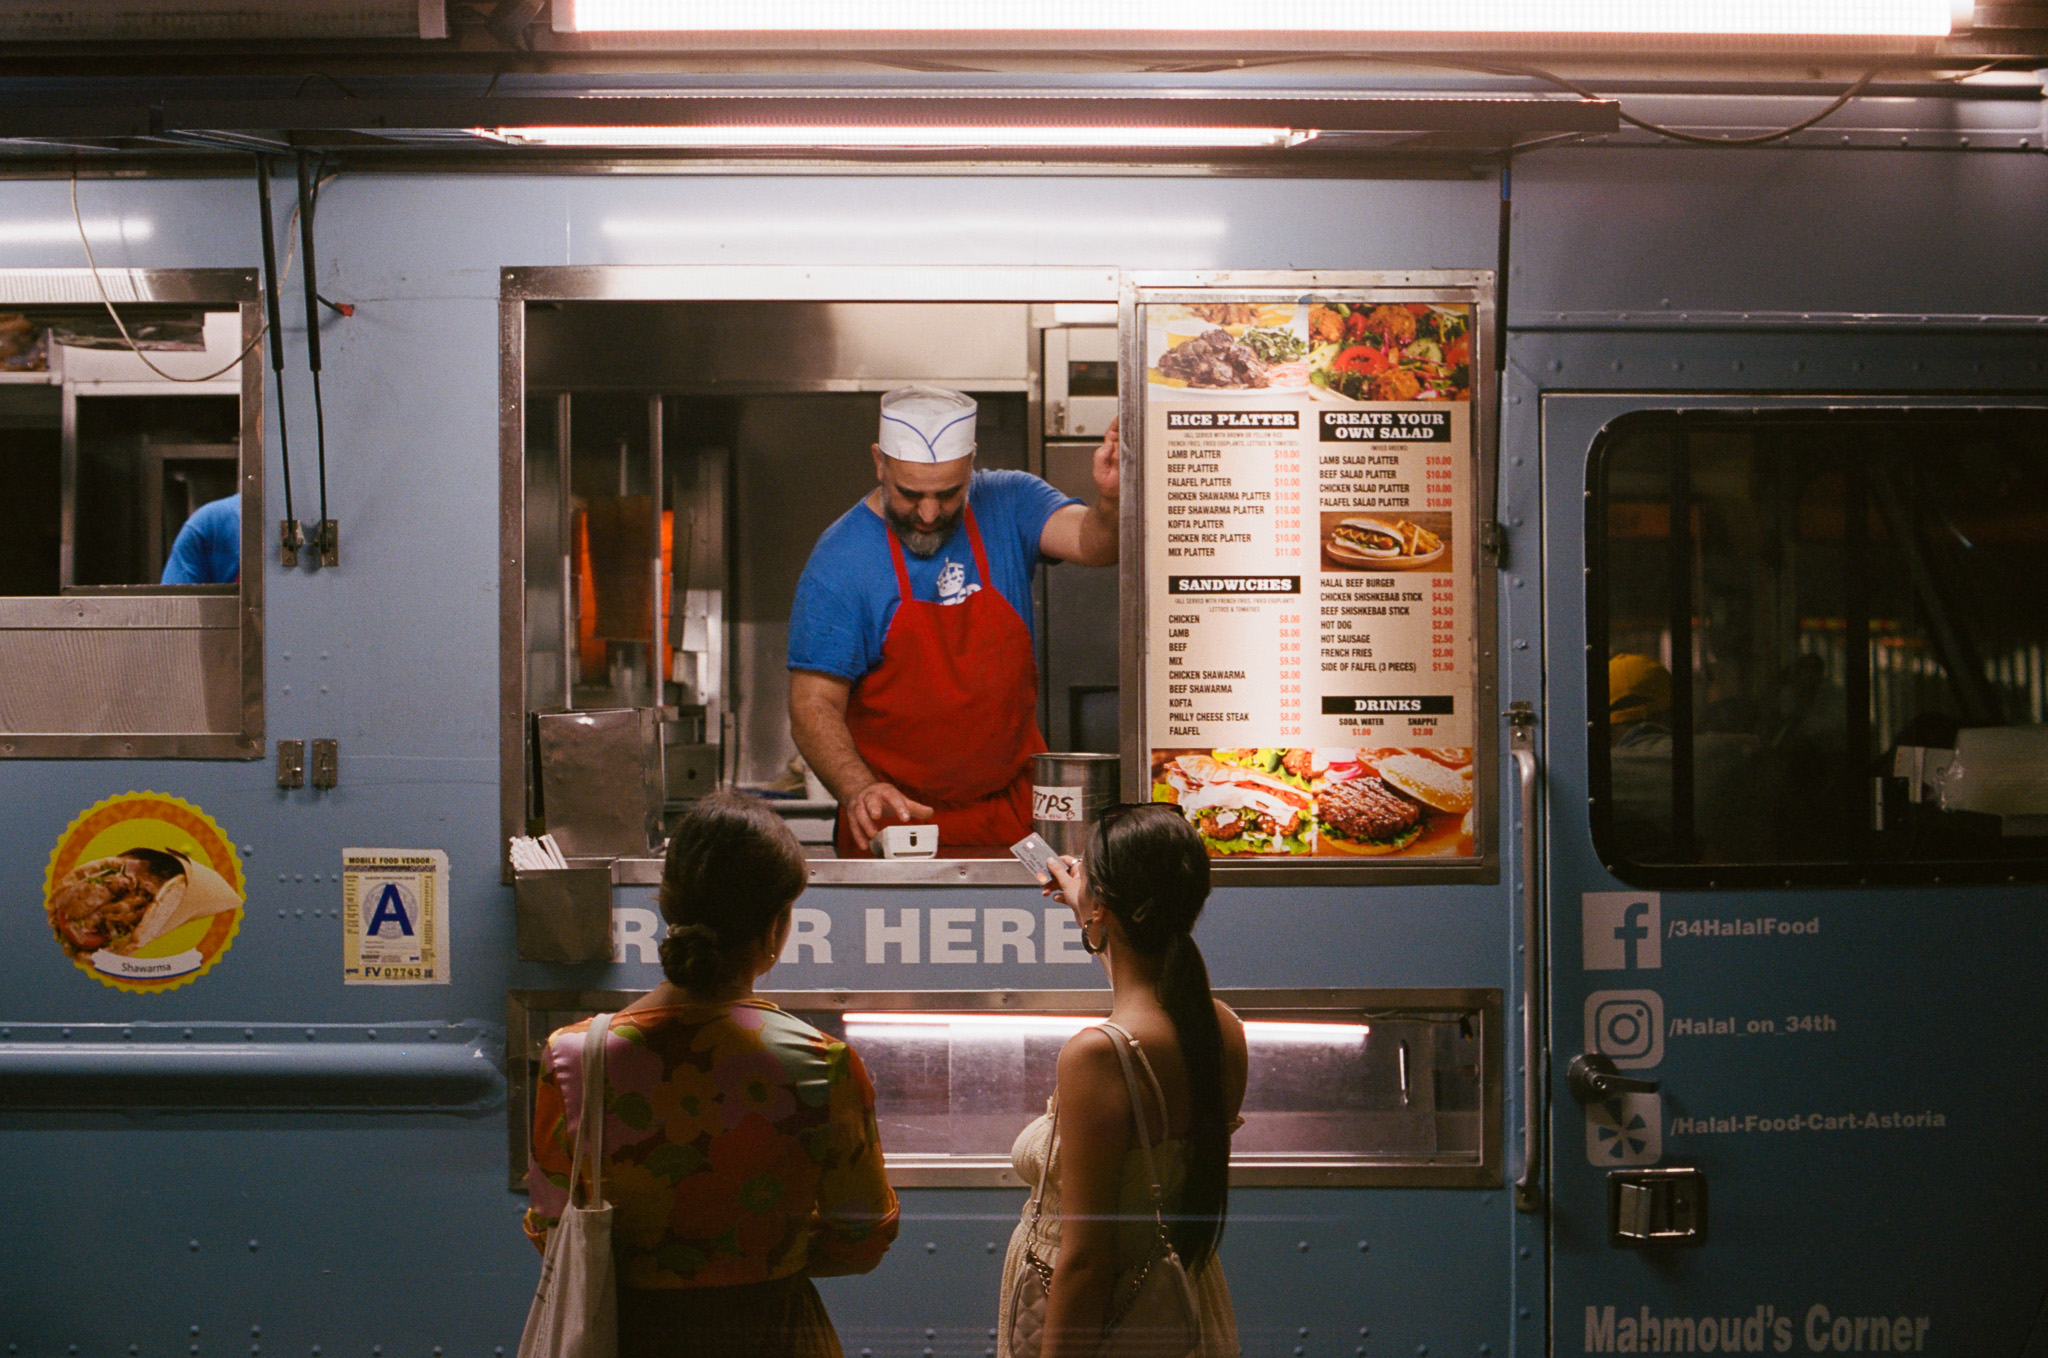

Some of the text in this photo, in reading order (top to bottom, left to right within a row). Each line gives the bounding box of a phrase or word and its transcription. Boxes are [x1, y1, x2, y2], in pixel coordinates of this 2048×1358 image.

[1170, 414, 1296, 425] RICE PLATTER
[1325, 414, 1444, 424] CREATE YOUR
[1336, 428, 1434, 438] OWN SALAD
[1168, 450, 1299, 458] LAMB PLATTER $10.00
[1320, 456, 1452, 465] LAMB SALAD PLATTER $10.00
[1168, 464, 1299, 472] BEEF PLATTER $10.00
[1320, 470, 1452, 479] BEEF SALAD PLATTER $10.00
[1168, 478, 1300, 486] FALAFEL PLATTER $10.00
[1320, 484, 1452, 493] CHICKEN SALAD PLATTER $10.00
[1168, 492, 1300, 500] CHICKEN SHAWARMA PLATTER $10.00
[1320, 498, 1452, 507] FALAFEL SALAD PLATTER $10.00
[1168, 506, 1300, 514] BEEF SHAWARMA PLATTER $10.00
[1168, 520, 1300, 528] KOFTA PLATTER $10.00
[1168, 534, 1300, 542] CHICKEN RICE PLATTER $10.00
[1168, 548, 1300, 556] MIX PLATTER $11.00
[1179, 579, 1292, 590] SANDWICHES
[1321, 579, 1453, 587] HALAL BEEF BURGER $8.00
[1321, 593, 1453, 601] CHICKEN SHISHKEBAB STICK $4.50
[1321, 607, 1453, 615] BEEF SHISHKEBAB STICK $4.50
[1169, 615, 1299, 623] CHICKEN $8.00
[1321, 621, 1453, 629] HOT DOG $2.00
[1169, 629, 1300, 637] LAMB $8.00
[1321, 635, 1453, 643] HOT SAUSAGE $2.50
[1169, 643, 1300, 651] BEEF $8.00
[1321, 649, 1453, 657] FRENCH FRIES $2.00
[1169, 657, 1300, 665] MIX $9.50
[1321, 663, 1337, 671] SIDE
[1340, 663, 1348, 671] OF
[1351, 663, 1376, 671] FALFEL
[1379, 663, 1386, 672] (3
[1388, 663, 1416, 673] PIECES)
[1169, 671, 1300, 679] CHICKEN SHAWARMA $8.00
[1169, 685, 1300, 693] BEEF SHAWARMA $8.00
[1169, 699, 1300, 707] KOFTA $8.00
[1355, 700, 1421, 711] DRINKS
[1169, 713, 1300, 721] PHILLY CHEESE STEAK $8.00
[1169, 727, 1300, 735] FALAFEL $5.00
[1352, 728, 1371, 736] $1.00
[1412, 728, 1433, 736] $2.00
[367, 884, 414, 936] A
[1667, 917, 1820, 939] /34HalalFood
[865, 908, 1092, 964] HERE
[121, 963, 172, 973] Shawarma
[365, 967, 421, 977] FV 07743
[1668, 1013, 1837, 1038] /Halal_on_34th
[1670, 1110, 1946, 1137] /Halal-Food-Cart-Astoria
[1584, 1303, 1931, 1353] Mahmoud's Corner
